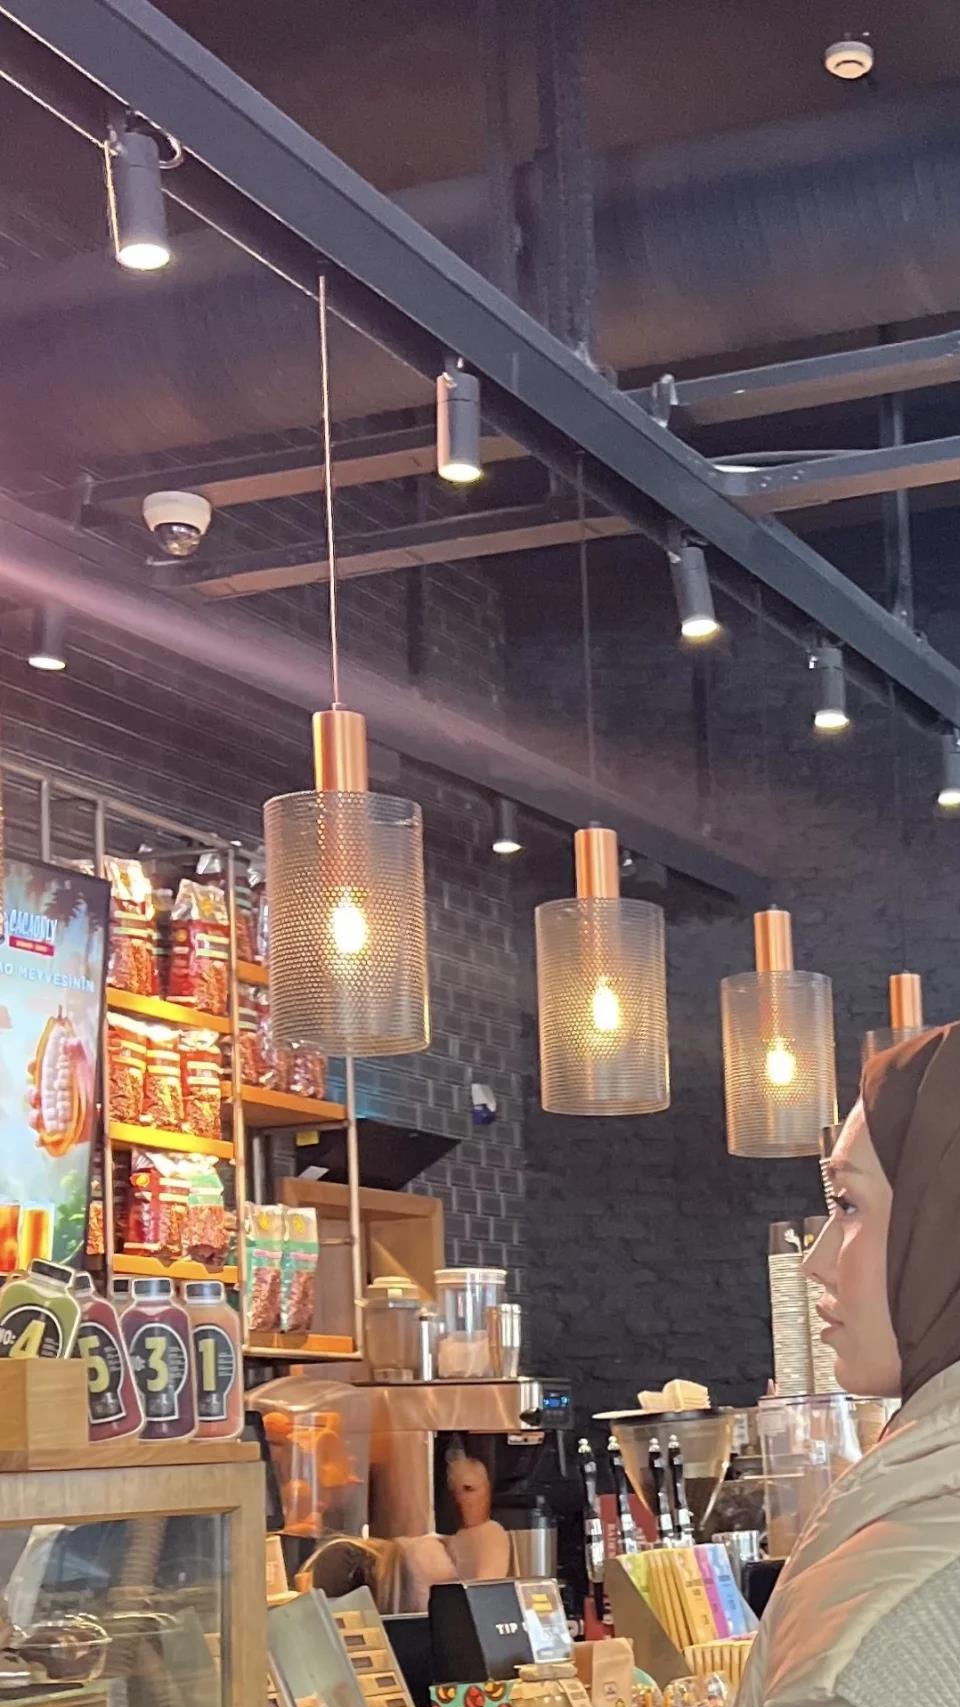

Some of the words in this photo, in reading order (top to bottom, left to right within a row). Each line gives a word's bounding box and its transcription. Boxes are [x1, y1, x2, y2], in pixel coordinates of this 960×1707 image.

[9, 1319, 46, 1359] 4
[78, 1335, 110, 1393] 5
[145, 1336, 169, 1392] 3
[199, 1338, 216, 1391] 1
[495, 1622, 519, 1635] TIP
